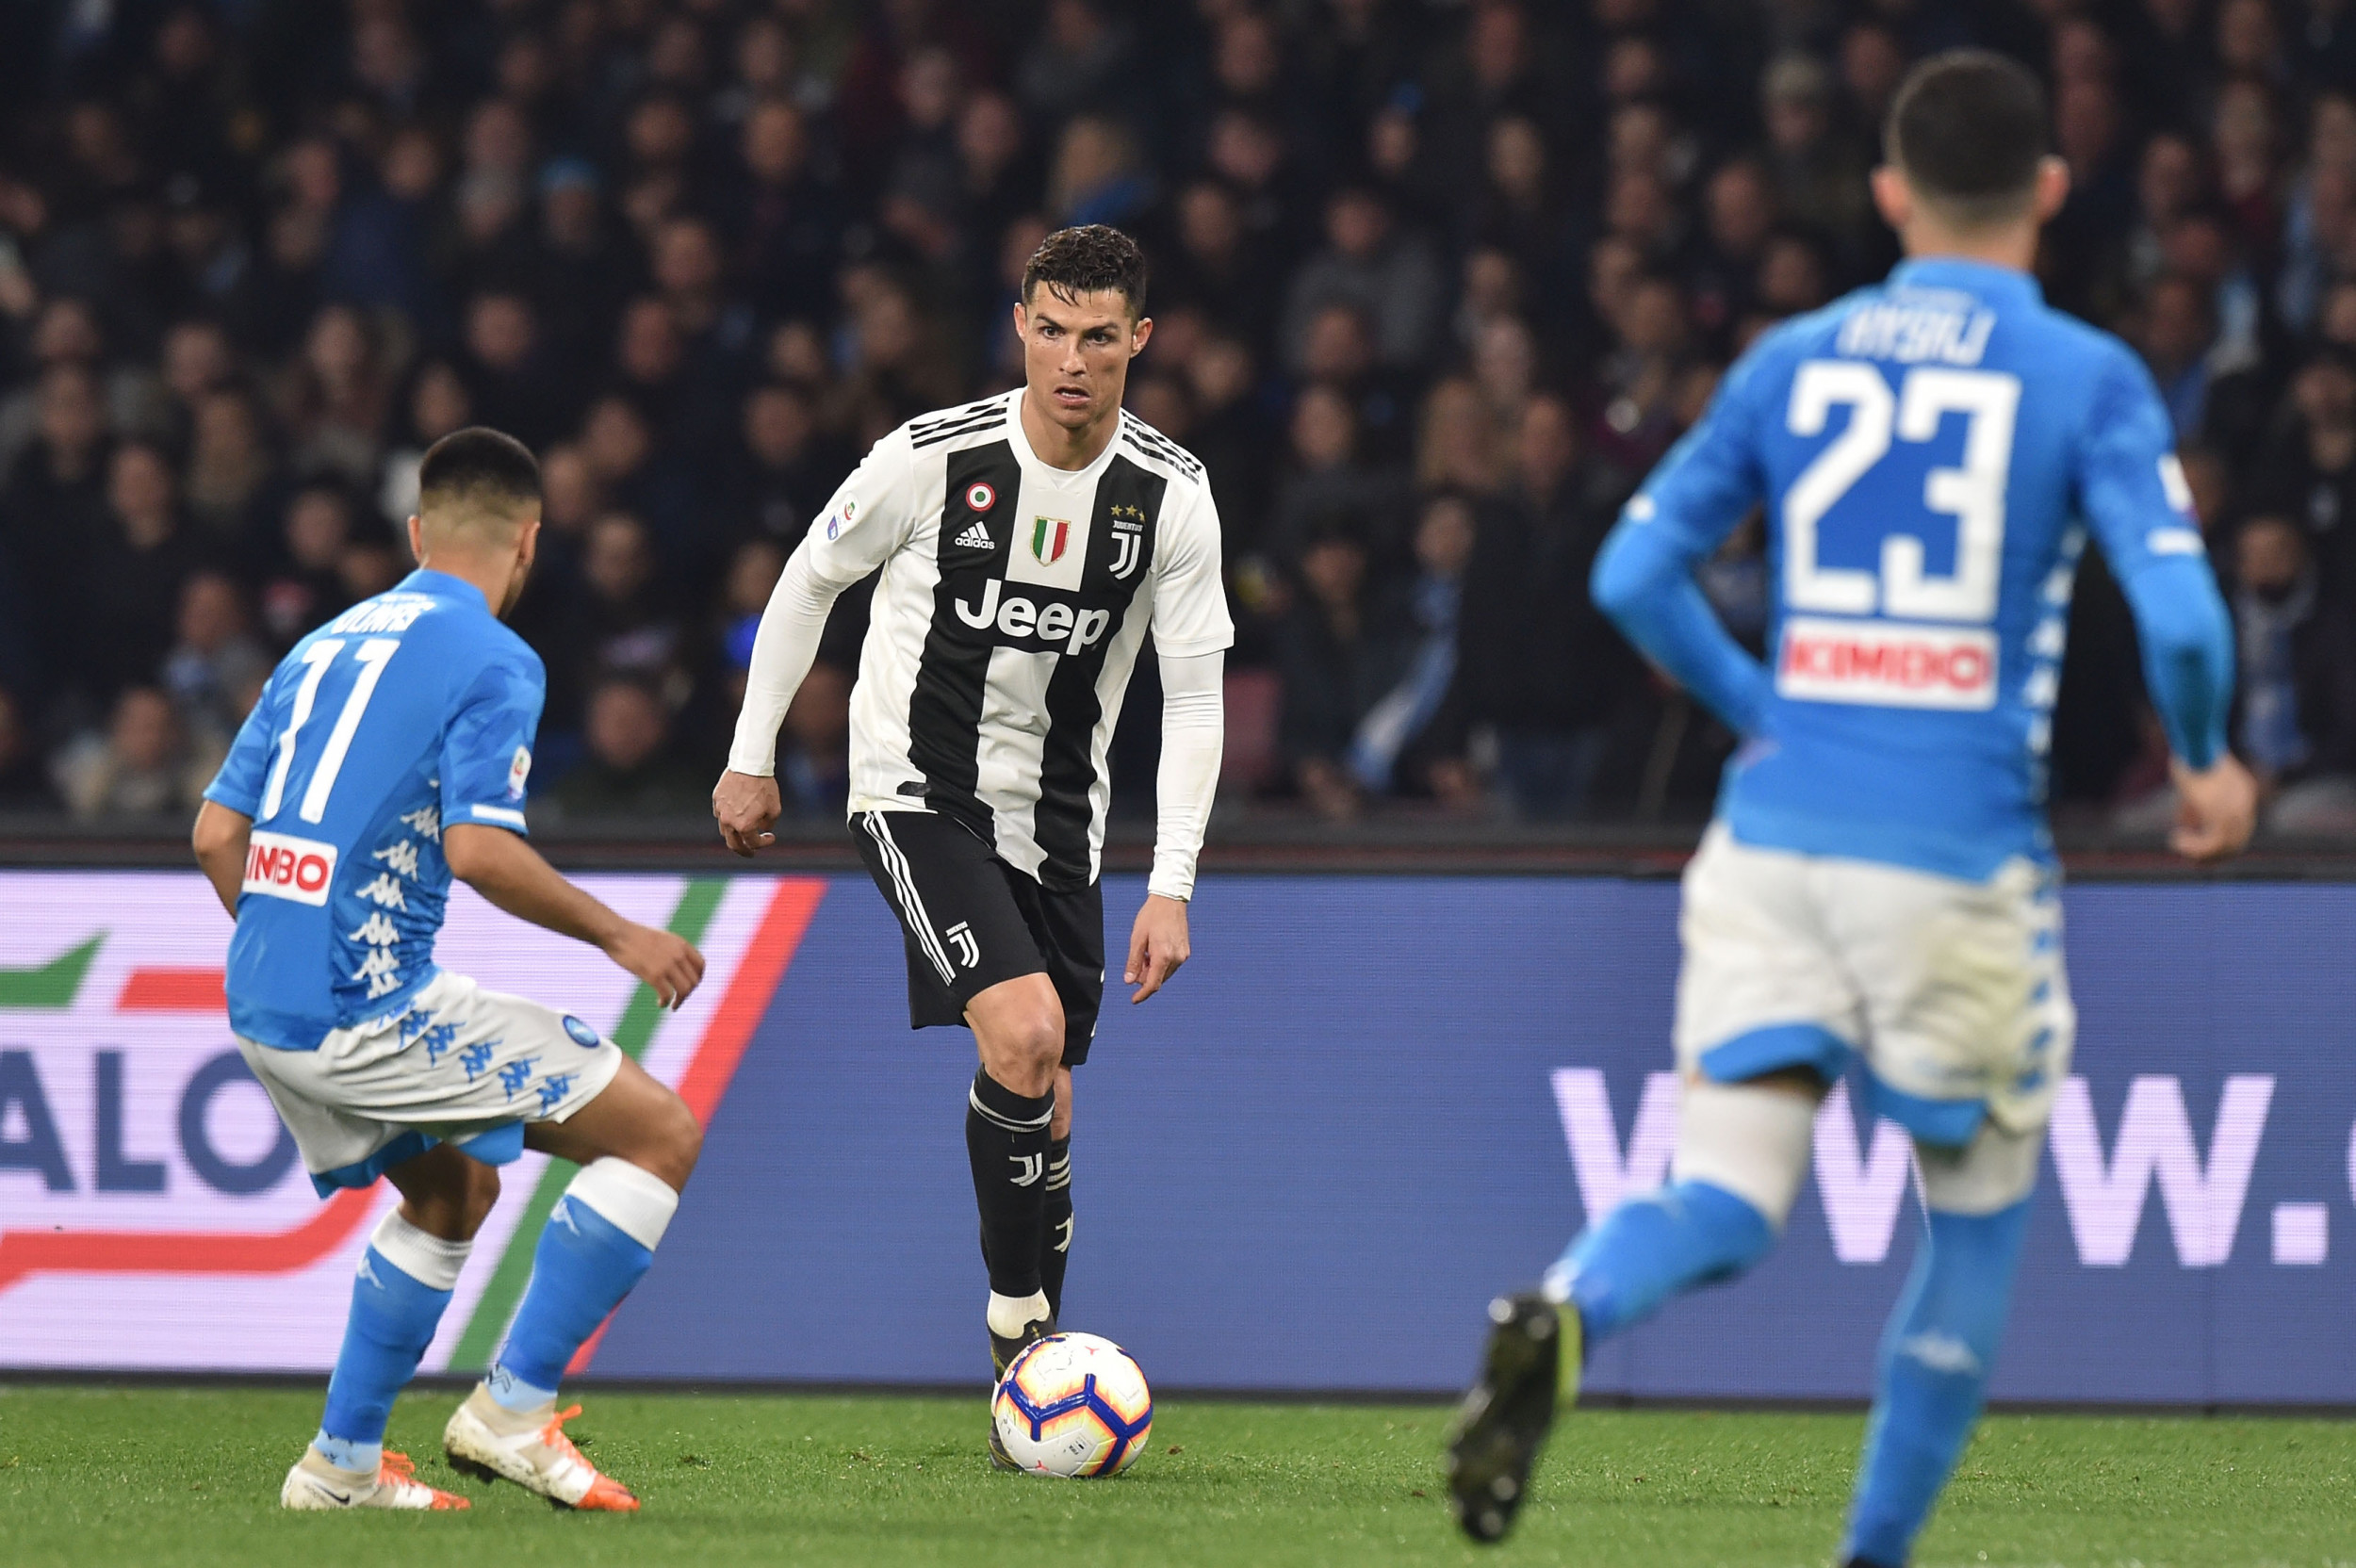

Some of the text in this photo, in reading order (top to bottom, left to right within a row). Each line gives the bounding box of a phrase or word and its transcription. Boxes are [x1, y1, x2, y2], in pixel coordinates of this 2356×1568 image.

[1783, 359, 2022, 624] 23
[955, 578, 1110, 656] Jeep
[1784, 637, 1993, 692] KIMBO
[262, 638, 401, 825] 11
[244, 843, 328, 892] IMBO
[0, 1048, 303, 1197] ALO
